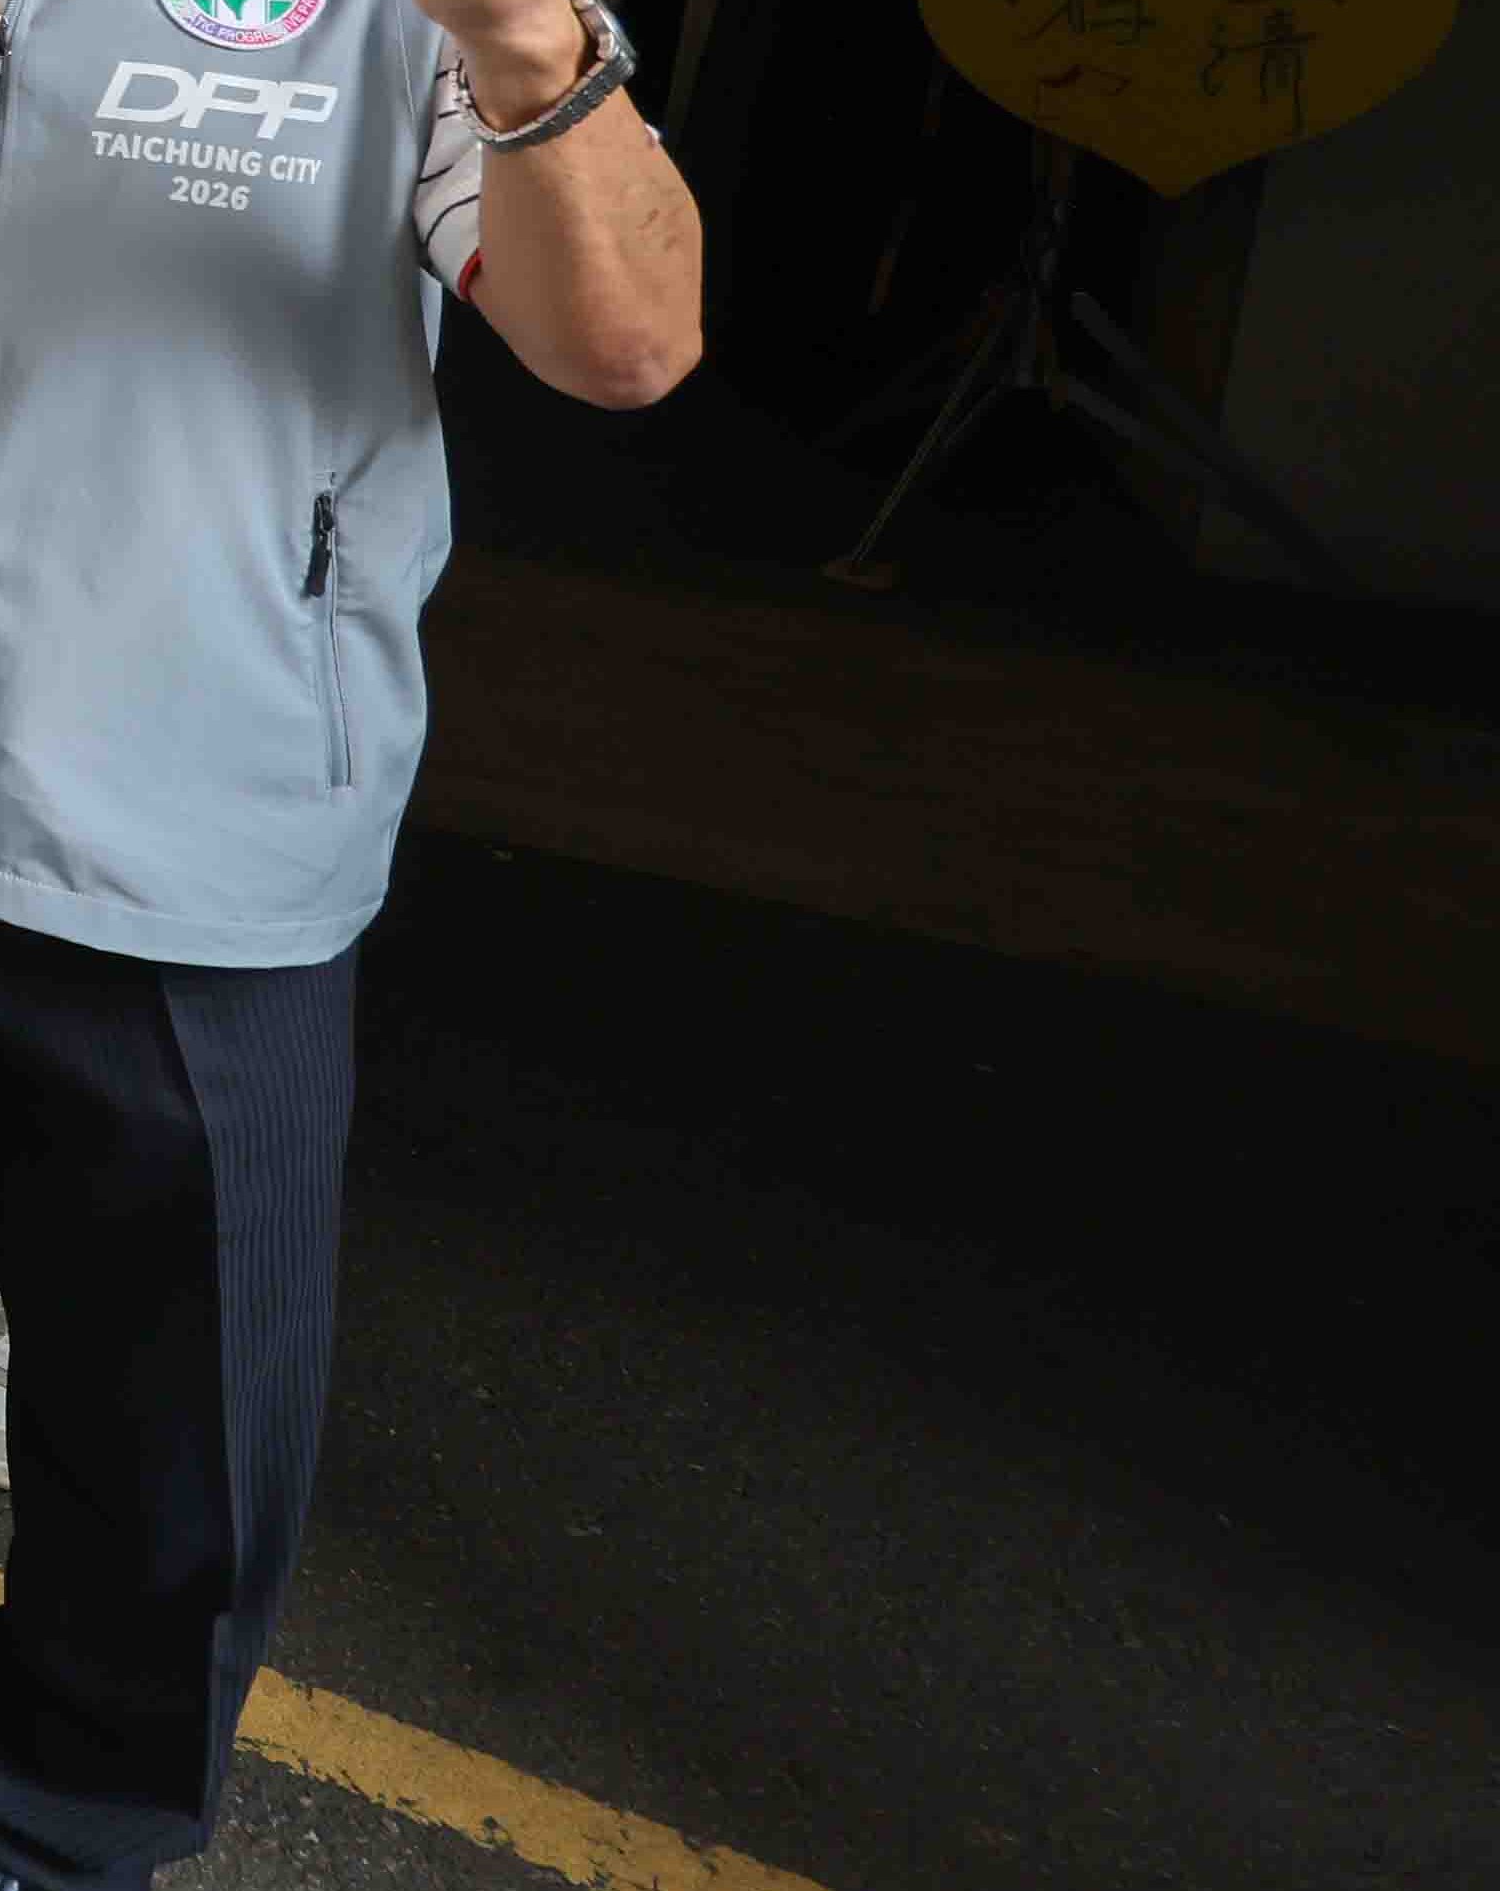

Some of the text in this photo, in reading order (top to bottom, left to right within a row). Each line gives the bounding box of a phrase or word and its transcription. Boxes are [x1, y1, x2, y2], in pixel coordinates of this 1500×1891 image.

[94, 60, 339, 140] DPP
[91, 130, 323, 186] TAICHUNG CITY
[169, 174, 250, 211] 2026
